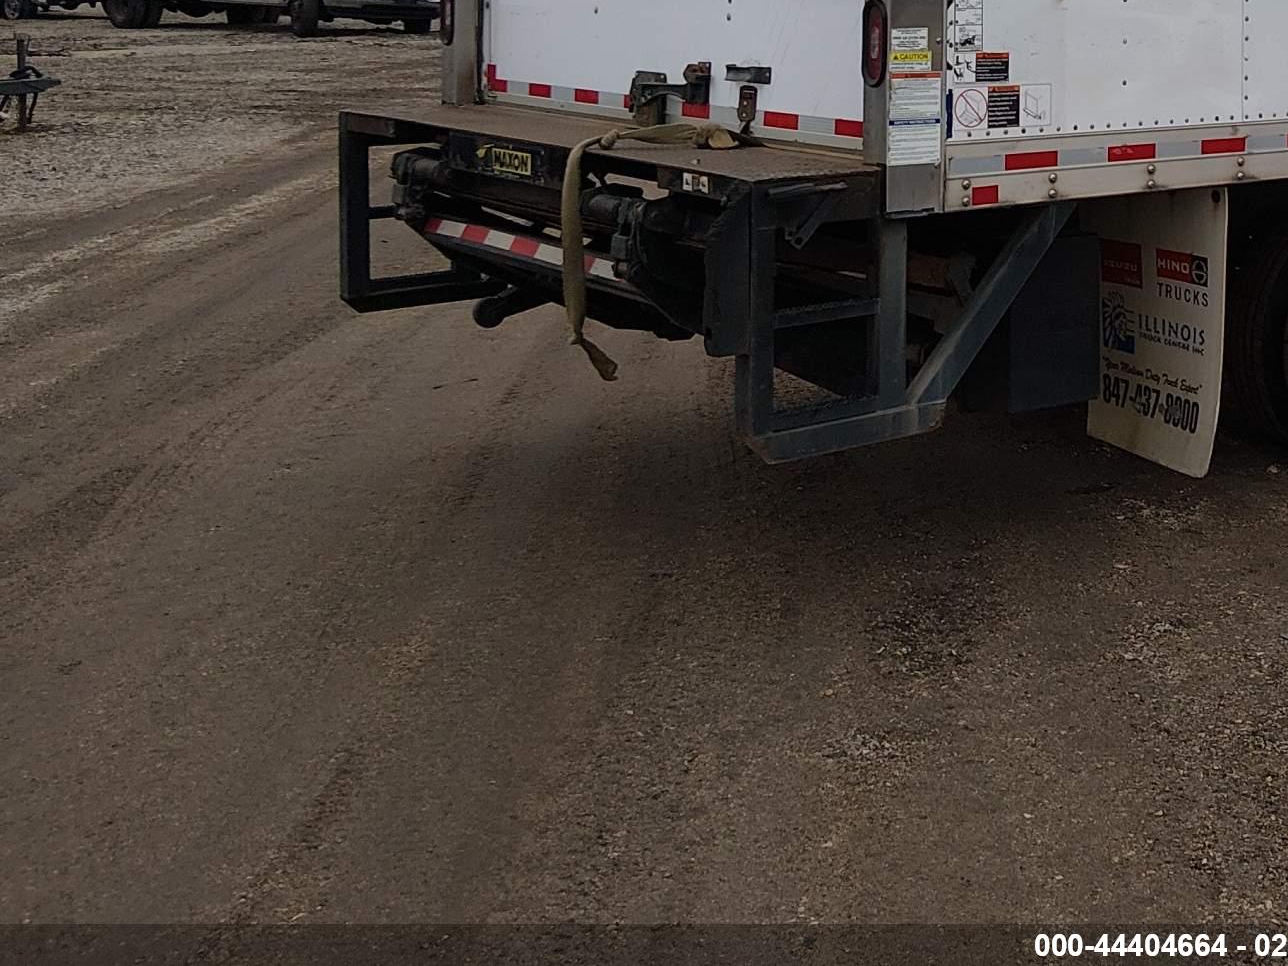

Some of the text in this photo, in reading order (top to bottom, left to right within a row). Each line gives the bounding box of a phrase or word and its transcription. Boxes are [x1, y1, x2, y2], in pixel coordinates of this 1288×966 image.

[899, 53, 929, 61] CAUTION
[493, 150, 529, 173] MAXON
[1156, 257, 1191, 275] HINO
[1156, 281, 1209, 308] TRUCKS
[1138, 313, 1206, 347] ILLINOIS
